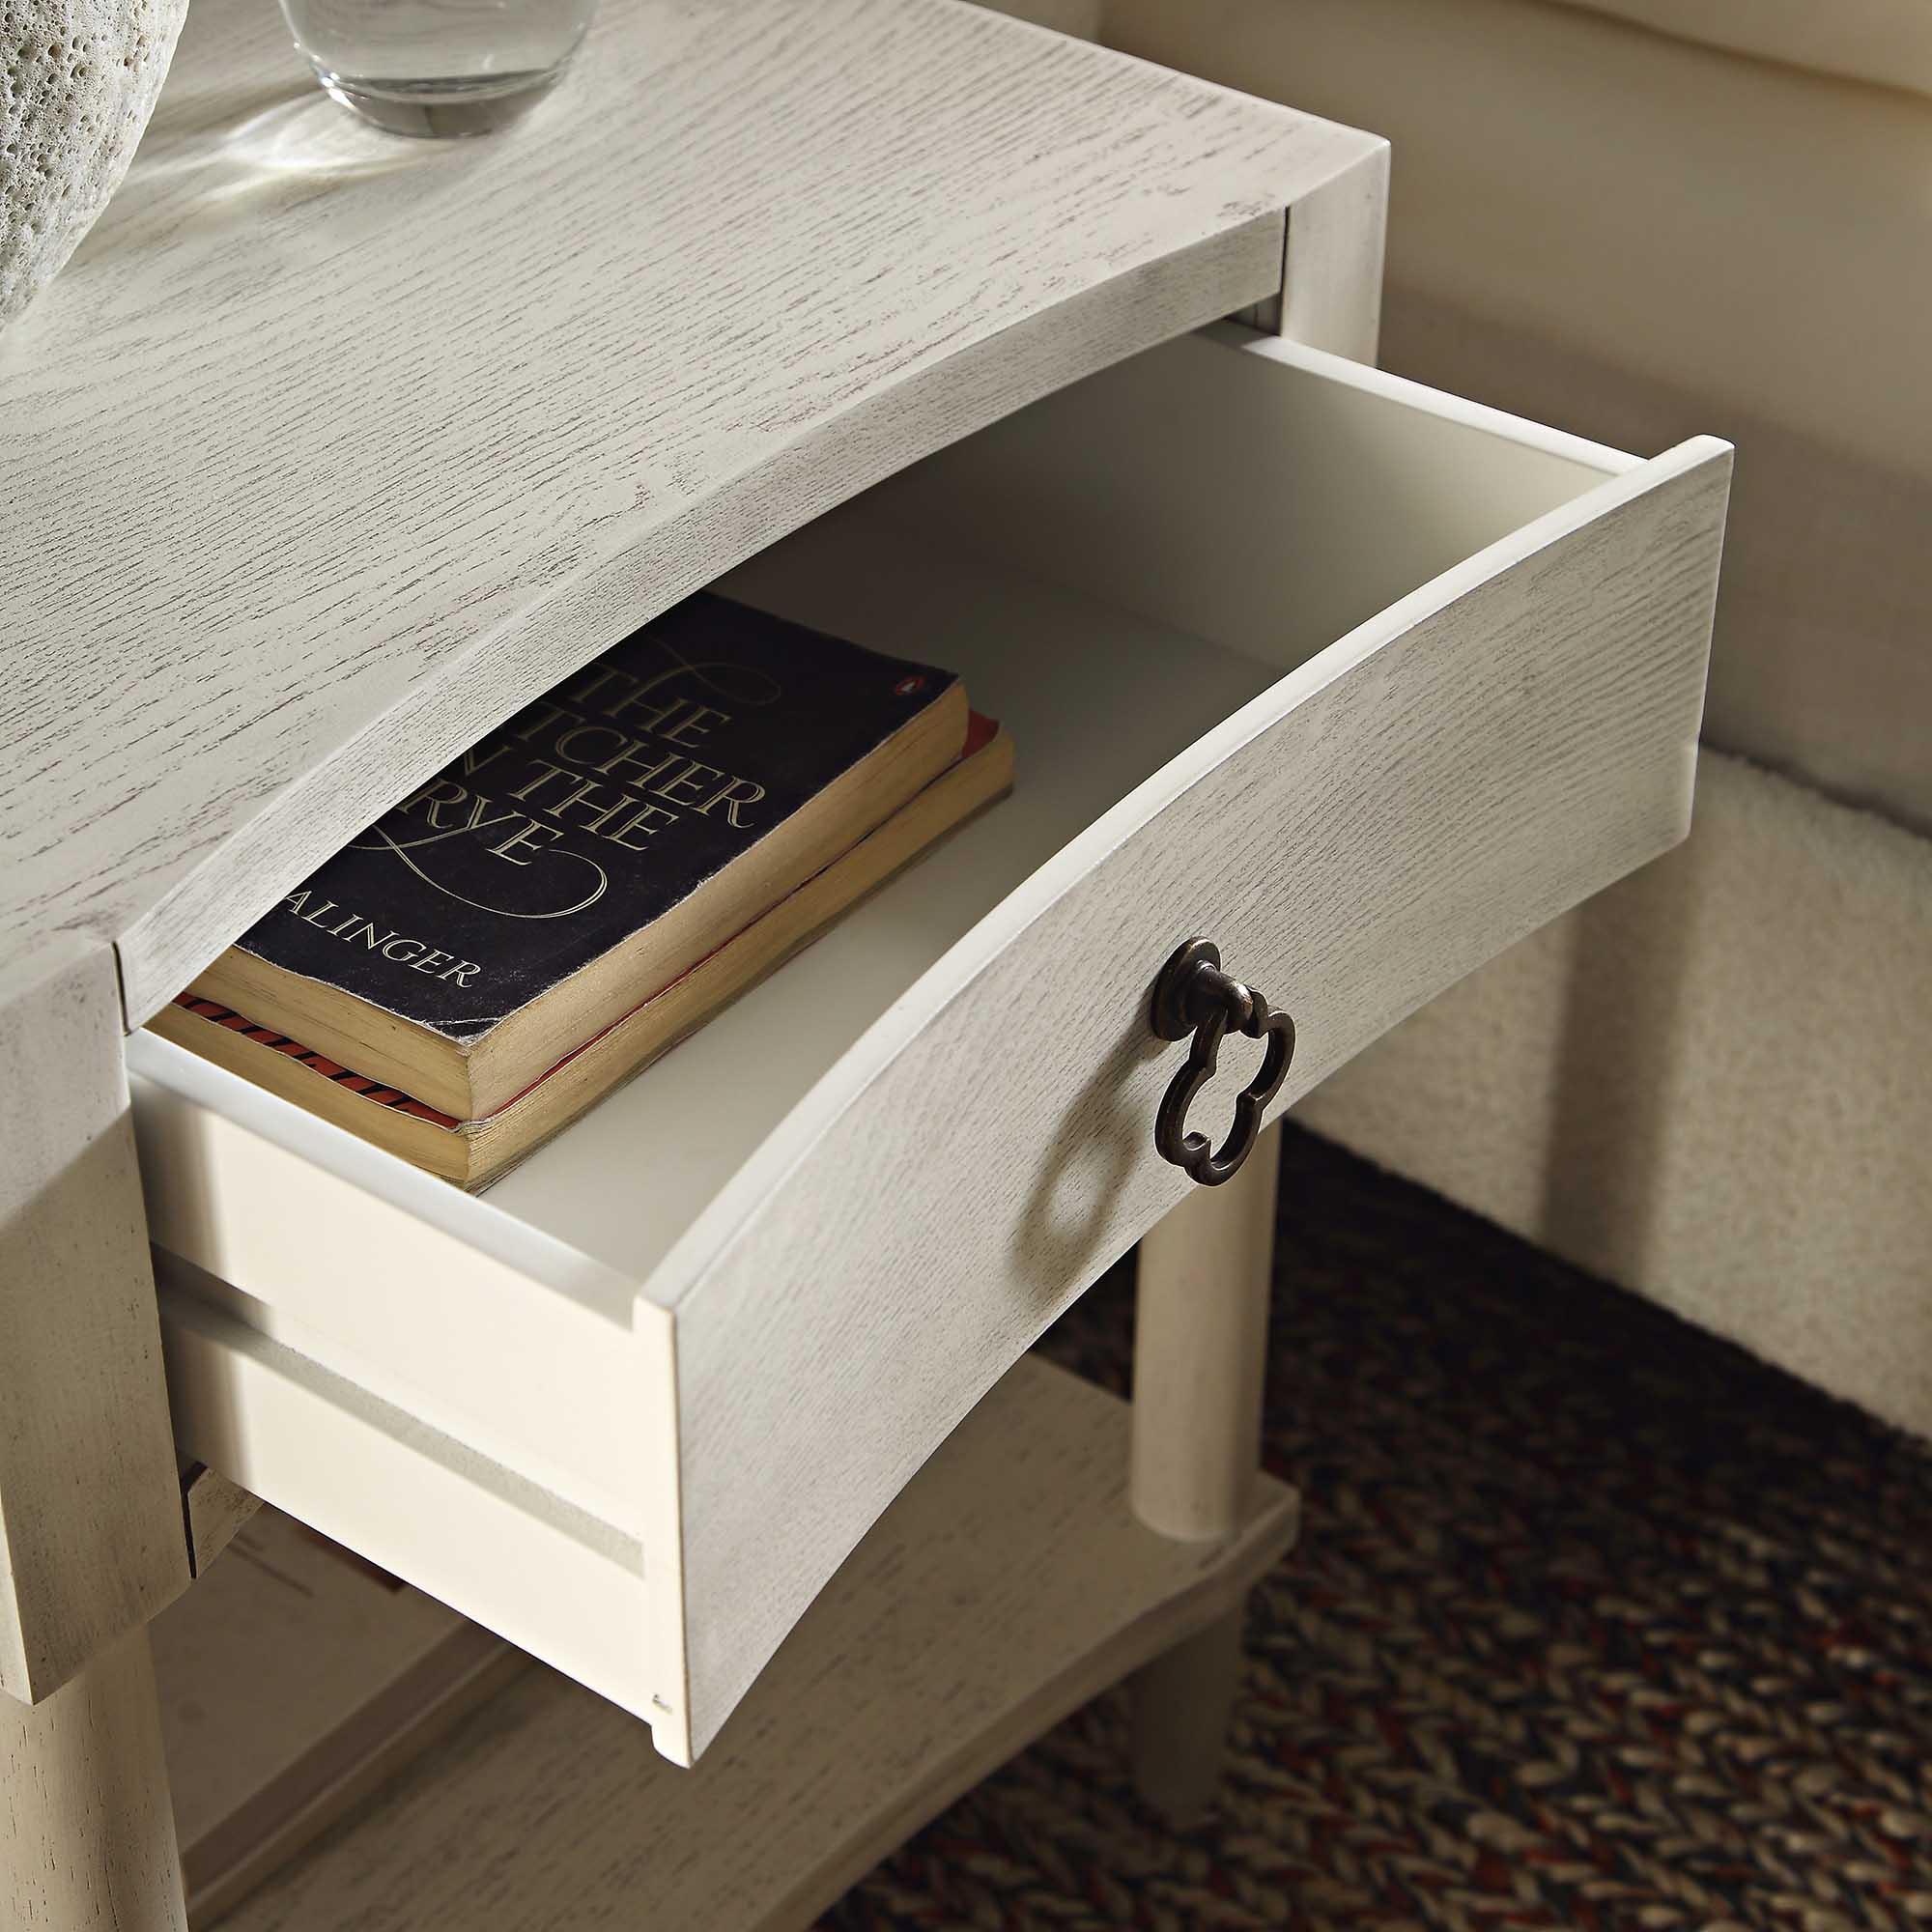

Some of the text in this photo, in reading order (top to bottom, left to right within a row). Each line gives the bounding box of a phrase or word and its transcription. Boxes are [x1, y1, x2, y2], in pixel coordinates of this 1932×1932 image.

[570, 663, 732, 749] THE
[397, 779, 566, 866] RYE
[508, 759, 680, 851] THE
[283, 890, 482, 988] ALINGER
